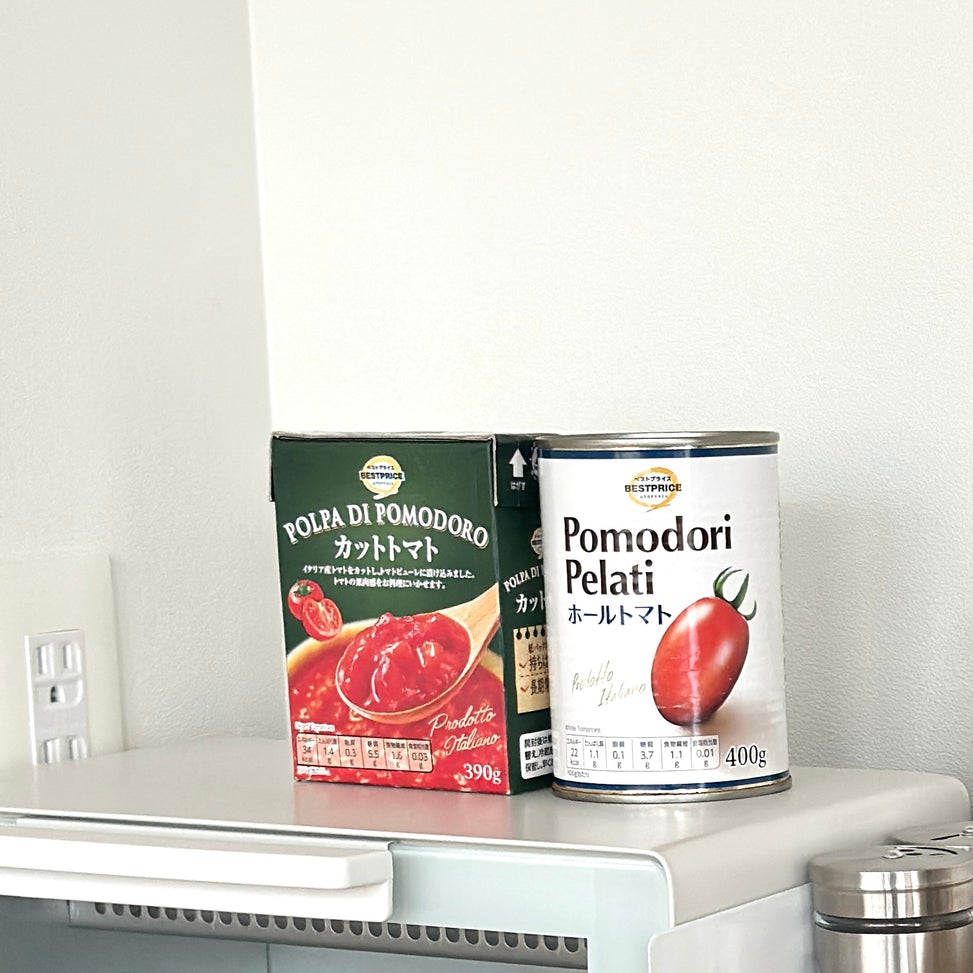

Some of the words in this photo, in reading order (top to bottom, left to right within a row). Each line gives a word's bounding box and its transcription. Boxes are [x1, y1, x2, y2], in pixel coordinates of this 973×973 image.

[360, 472, 403, 480] BESTPRICE
[625, 484, 682, 493] BESTPRICE
[283, 507, 345, 545] POLPA
[347, 503, 371, 526] DI
[374, 503, 490, 549] POMODORO
[564, 514, 732, 553] Pomodori
[334, 534, 439, 563] カットトマト
[503, 569, 531, 592] POLPA
[530, 565, 540, 578] DI
[566, 559, 654, 596] Pelati
[568, 604, 672, 626] ホールトマト
[428, 705, 497, 737] Prodotto
[443, 728, 501, 756] Italiano
[589, 750, 599, 759] 1.1
[612, 750, 625, 759] 0.1
[640, 750, 654, 760] 3.7
[670, 750, 683, 759] 1.1
[725, 745, 767, 767] 400g
[463, 763, 502, 785] 390g
